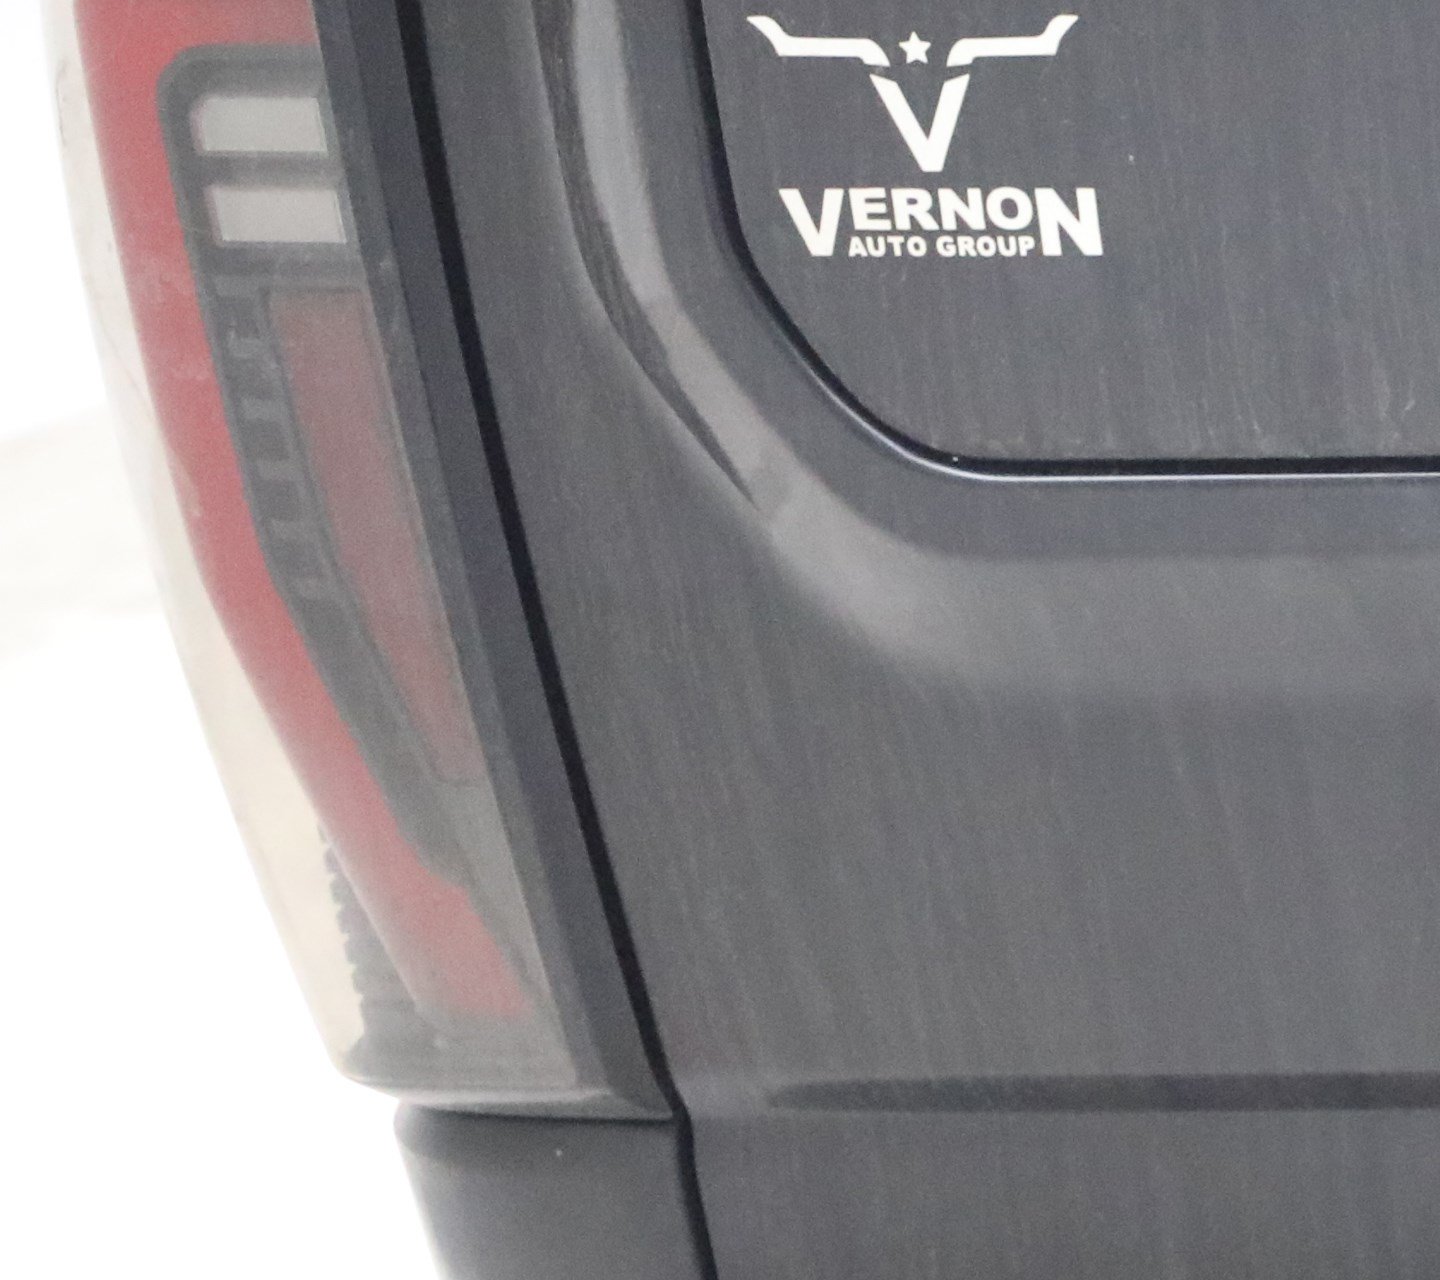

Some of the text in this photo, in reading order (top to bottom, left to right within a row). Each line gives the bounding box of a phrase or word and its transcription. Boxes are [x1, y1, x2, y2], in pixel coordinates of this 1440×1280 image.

[778, 186, 1104, 258] VERNON
[848, 234, 1036, 258] AUTO GROUP
